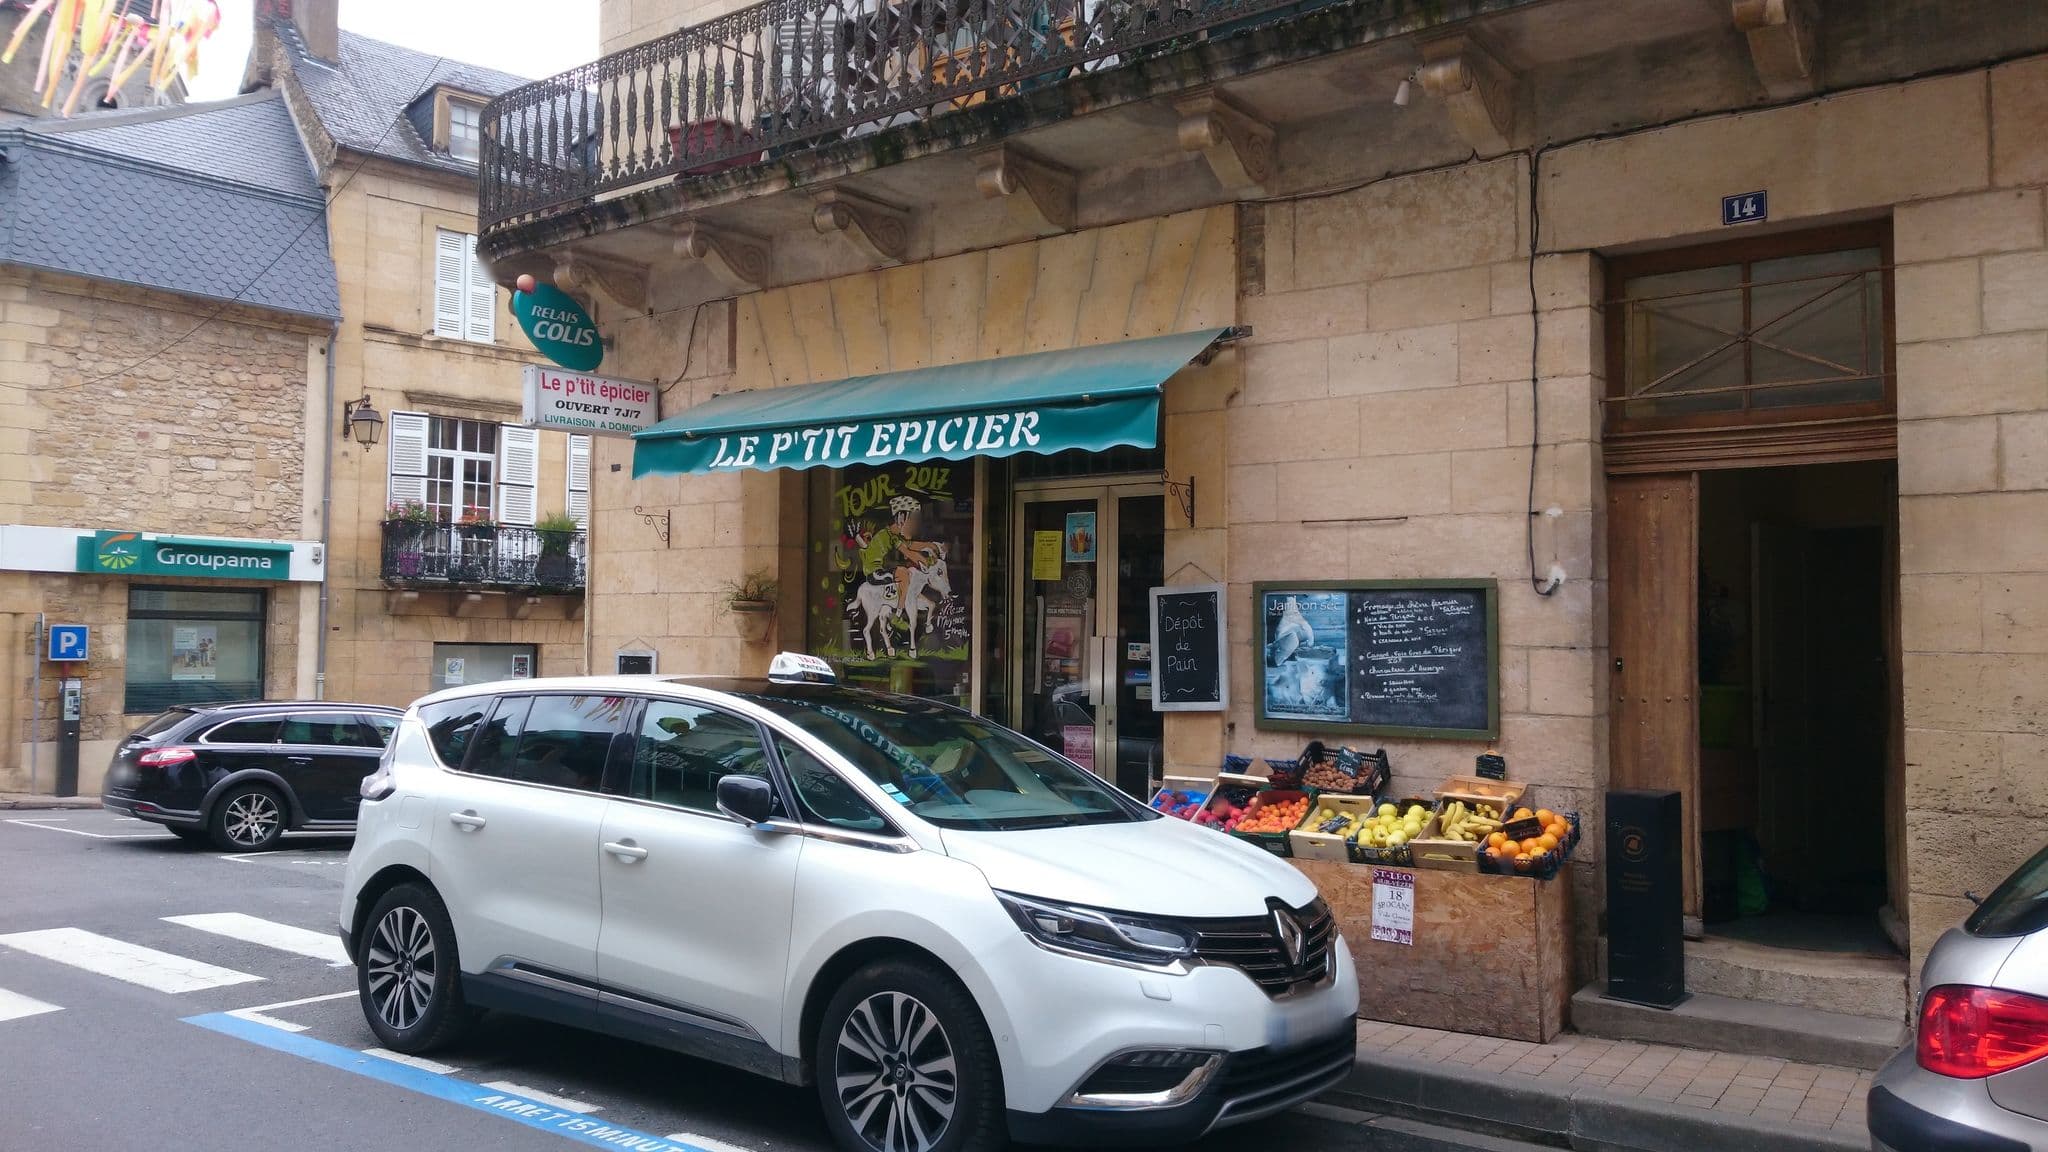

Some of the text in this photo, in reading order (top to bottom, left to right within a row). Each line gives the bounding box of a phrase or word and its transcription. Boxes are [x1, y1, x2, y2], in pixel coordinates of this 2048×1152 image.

[1732, 197, 1757, 218] 14
[531, 305, 579, 324] RELAIS
[533, 320, 596, 346] COLIS
[541, 372, 650, 403] Le p'tit épicier
[555, 400, 641, 418] OUVERT 7J/7
[545, 414, 595, 428] LIVRAISON
[600, 421, 607, 429] A
[709, 410, 1040, 468] LE P'TIT EPICIER
[835, 466, 950, 517] TOUR 2017
[156, 548, 272, 570] Groupama
[885, 585, 897, 598] 24
[1166, 612, 1205, 637] Dépôt
[60, 631, 77, 653] P
[1176, 636, 1192, 651] de
[1168, 655, 1199, 673] Pain
[1389, 890, 1403, 901] 18
[474, 1095, 570, 1121] ARRET
[558, 1118, 598, 1131] 15
